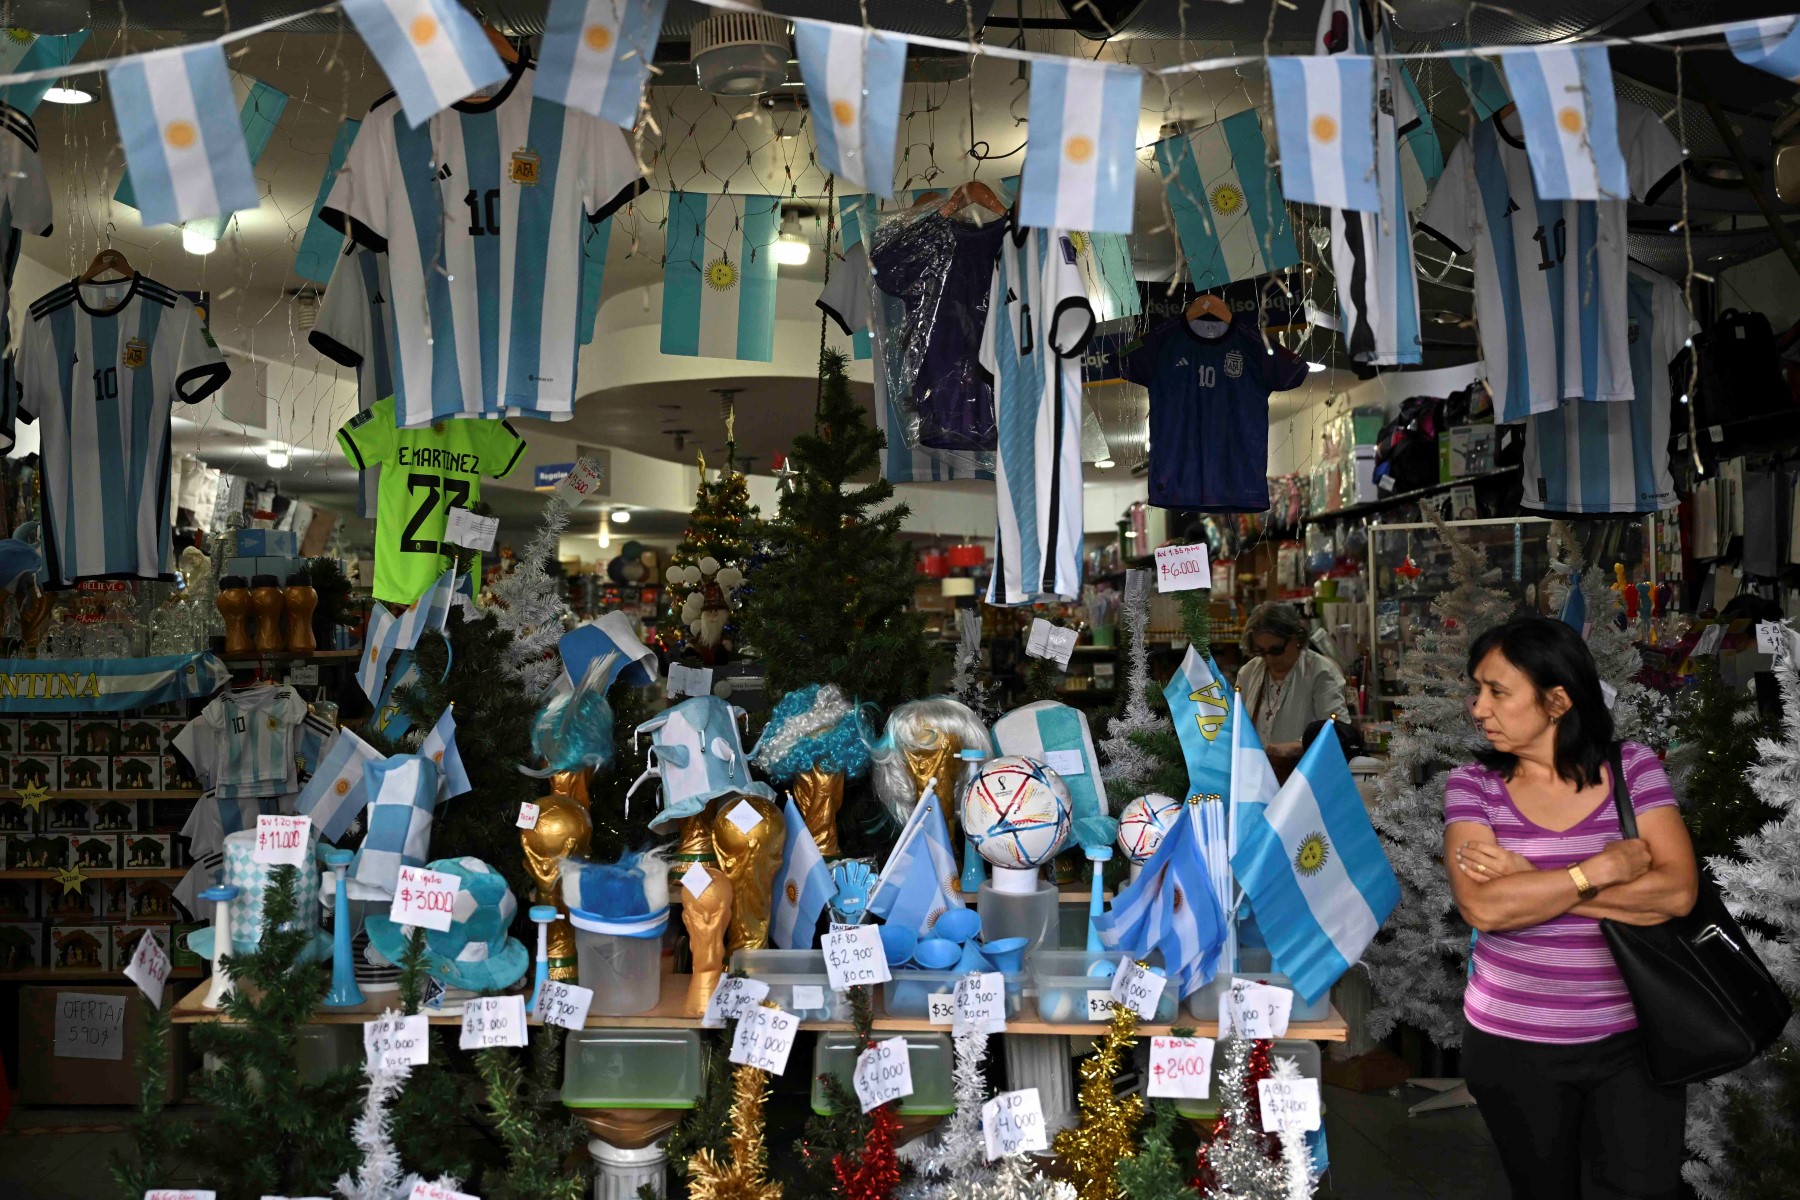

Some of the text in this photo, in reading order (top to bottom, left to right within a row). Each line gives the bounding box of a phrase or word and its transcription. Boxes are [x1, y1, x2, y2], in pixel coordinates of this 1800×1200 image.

[515, 161, 535, 178] AFA
[93, 366, 119, 402] 10
[1198, 364, 1216, 388] 10
[82, 583, 117, 591] BELIEVE
[232, 716, 246, 735] 10
[771, 1015, 788, 1031] 80
